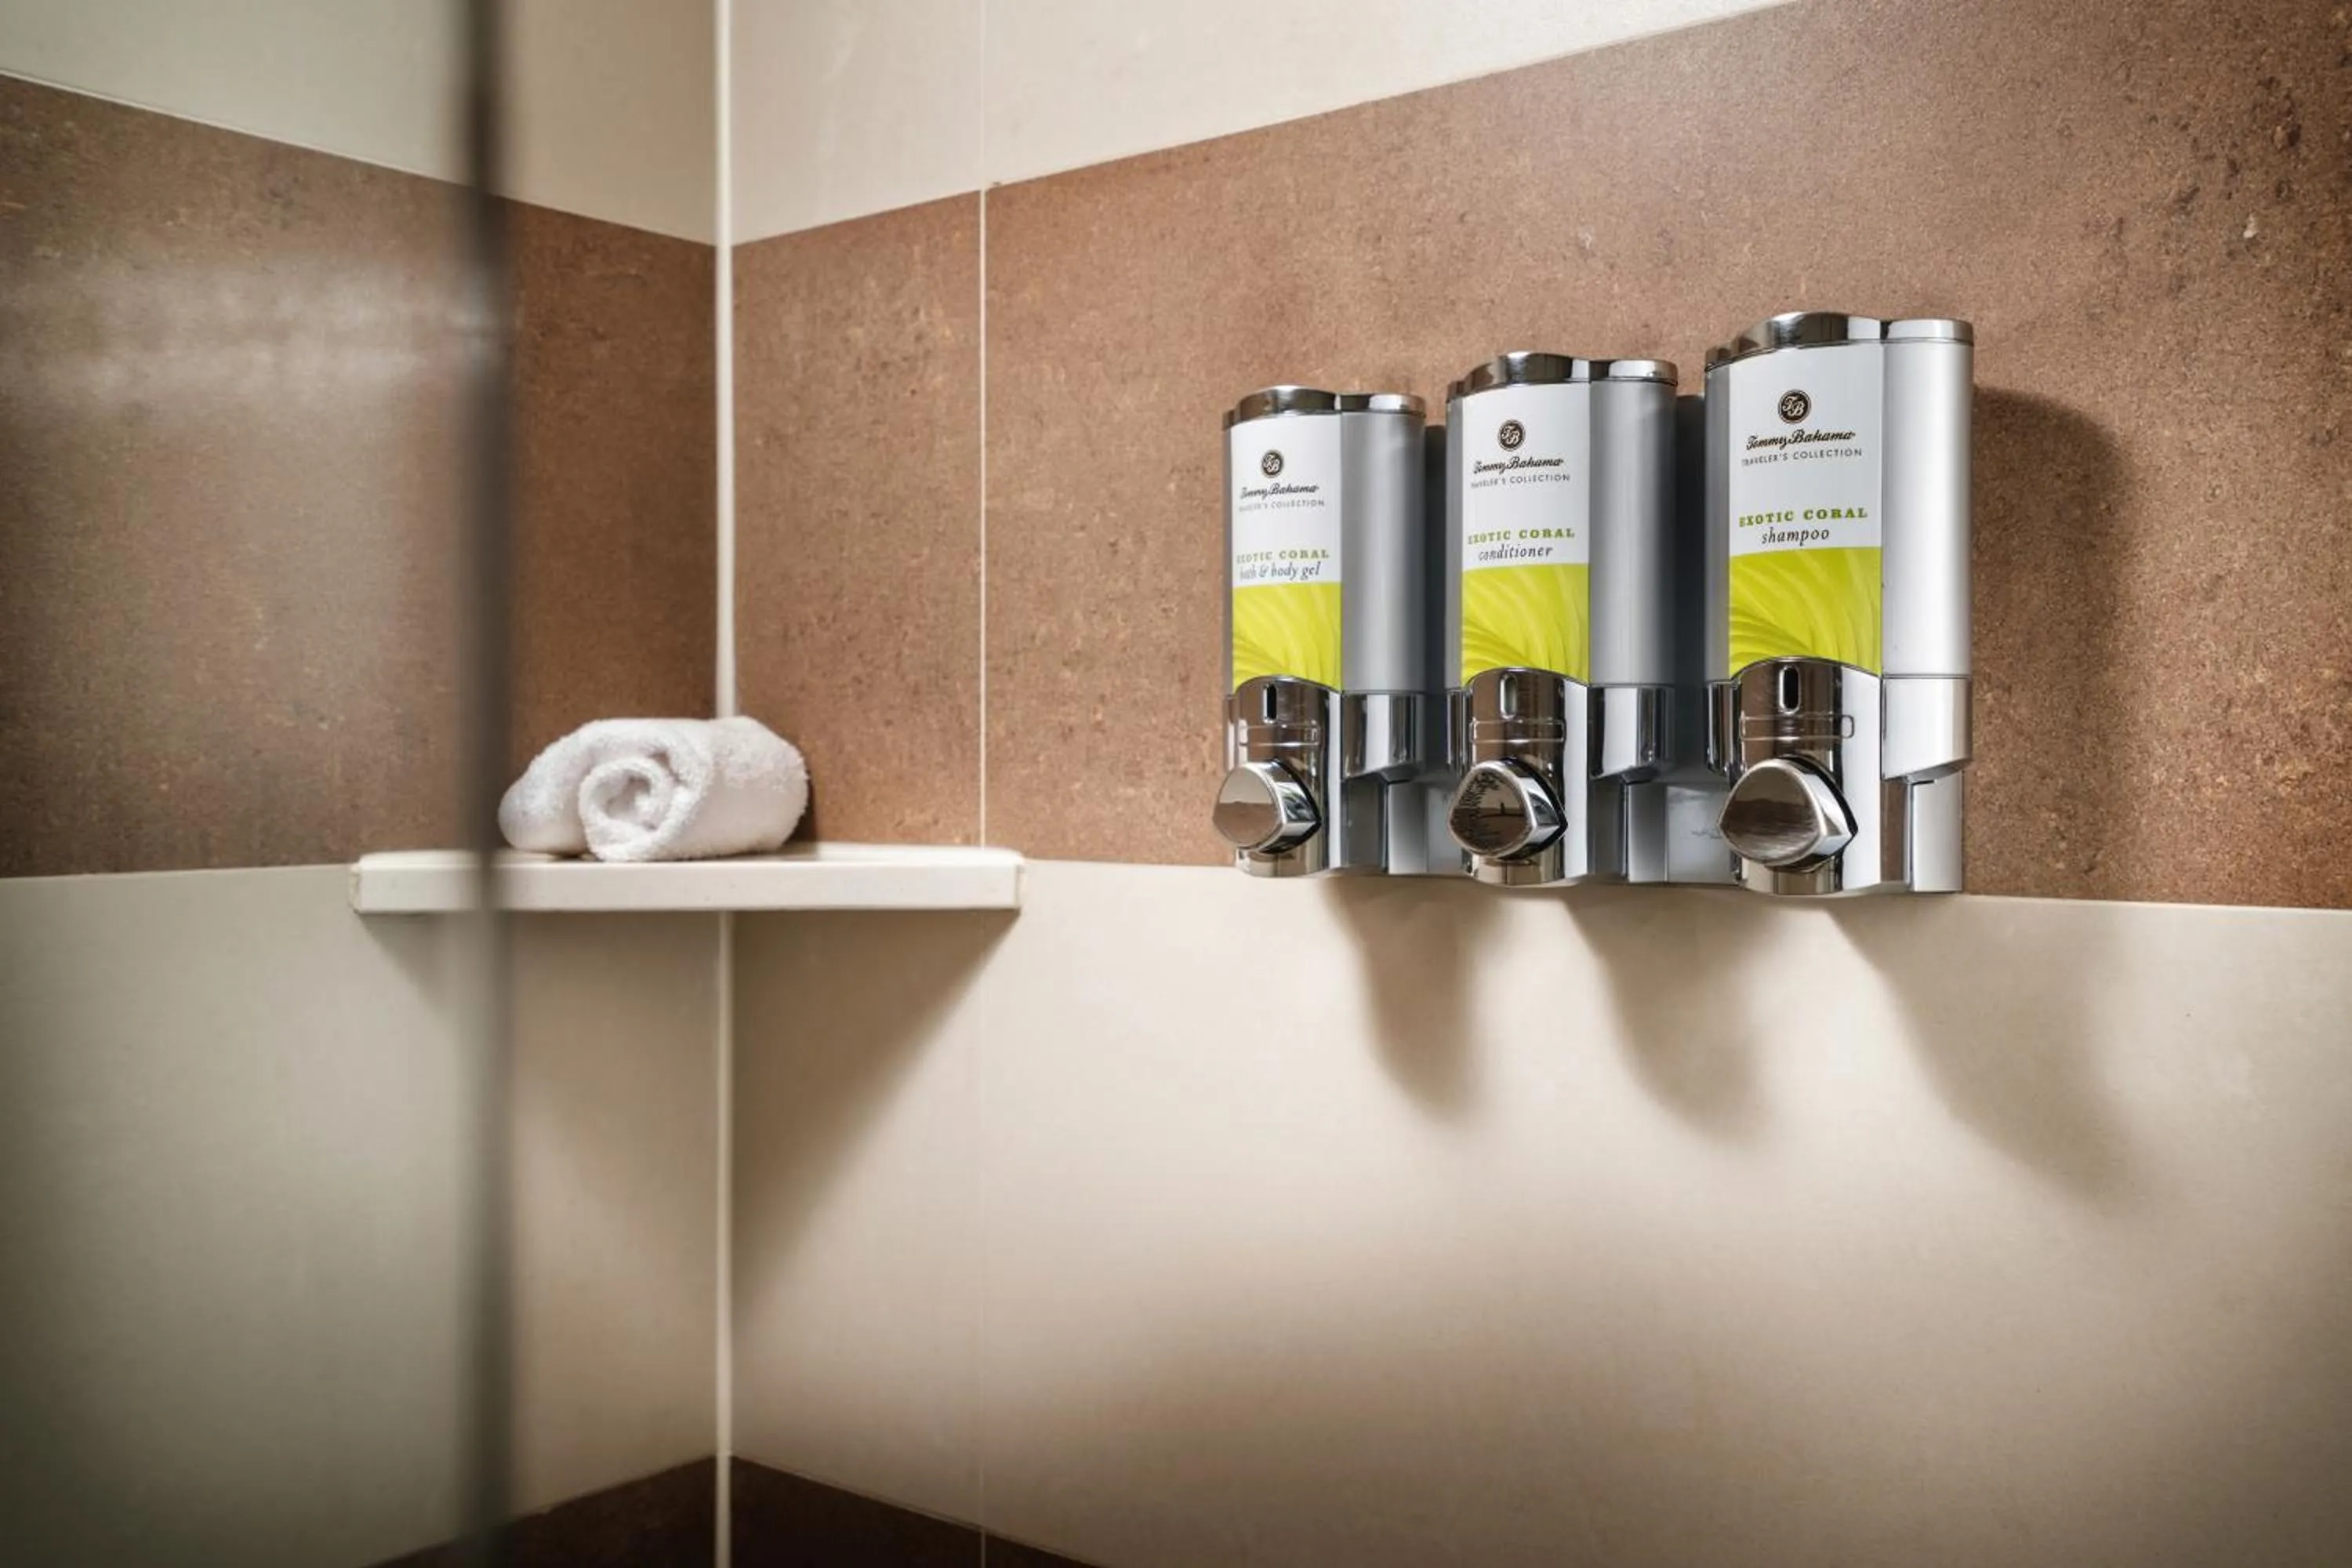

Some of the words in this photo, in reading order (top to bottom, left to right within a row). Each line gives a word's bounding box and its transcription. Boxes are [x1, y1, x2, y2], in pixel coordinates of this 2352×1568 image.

[1746, 435, 1788, 450] Tommy
[1788, 429, 1856, 445] Bahama
[1473, 460, 1504, 474] Tommy
[1506, 456, 1563, 469] Bahama
[1741, 453, 1788, 466] TRAVELER'S
[1793, 448, 1862, 459] COLLECTION
[1510, 474, 1570, 483] COLLECTION
[1269, 483, 1320, 495] Bahama
[1272, 499, 1325, 509] COLLECTION
[1739, 511, 1794, 527] EXOTIC
[1803, 508, 1867, 520] CORAL
[1468, 531, 1511, 544] EXOTIC
[1519, 528, 1575, 538] CORAL
[1762, 527, 1829, 546] shampoo
[1279, 550, 1329, 559] CORAL
[1479, 544, 1552, 561] conditioner
[1258, 564, 1269, 577] &
[1271, 562, 1298, 580] body
[1302, 561, 1321, 580] gel
